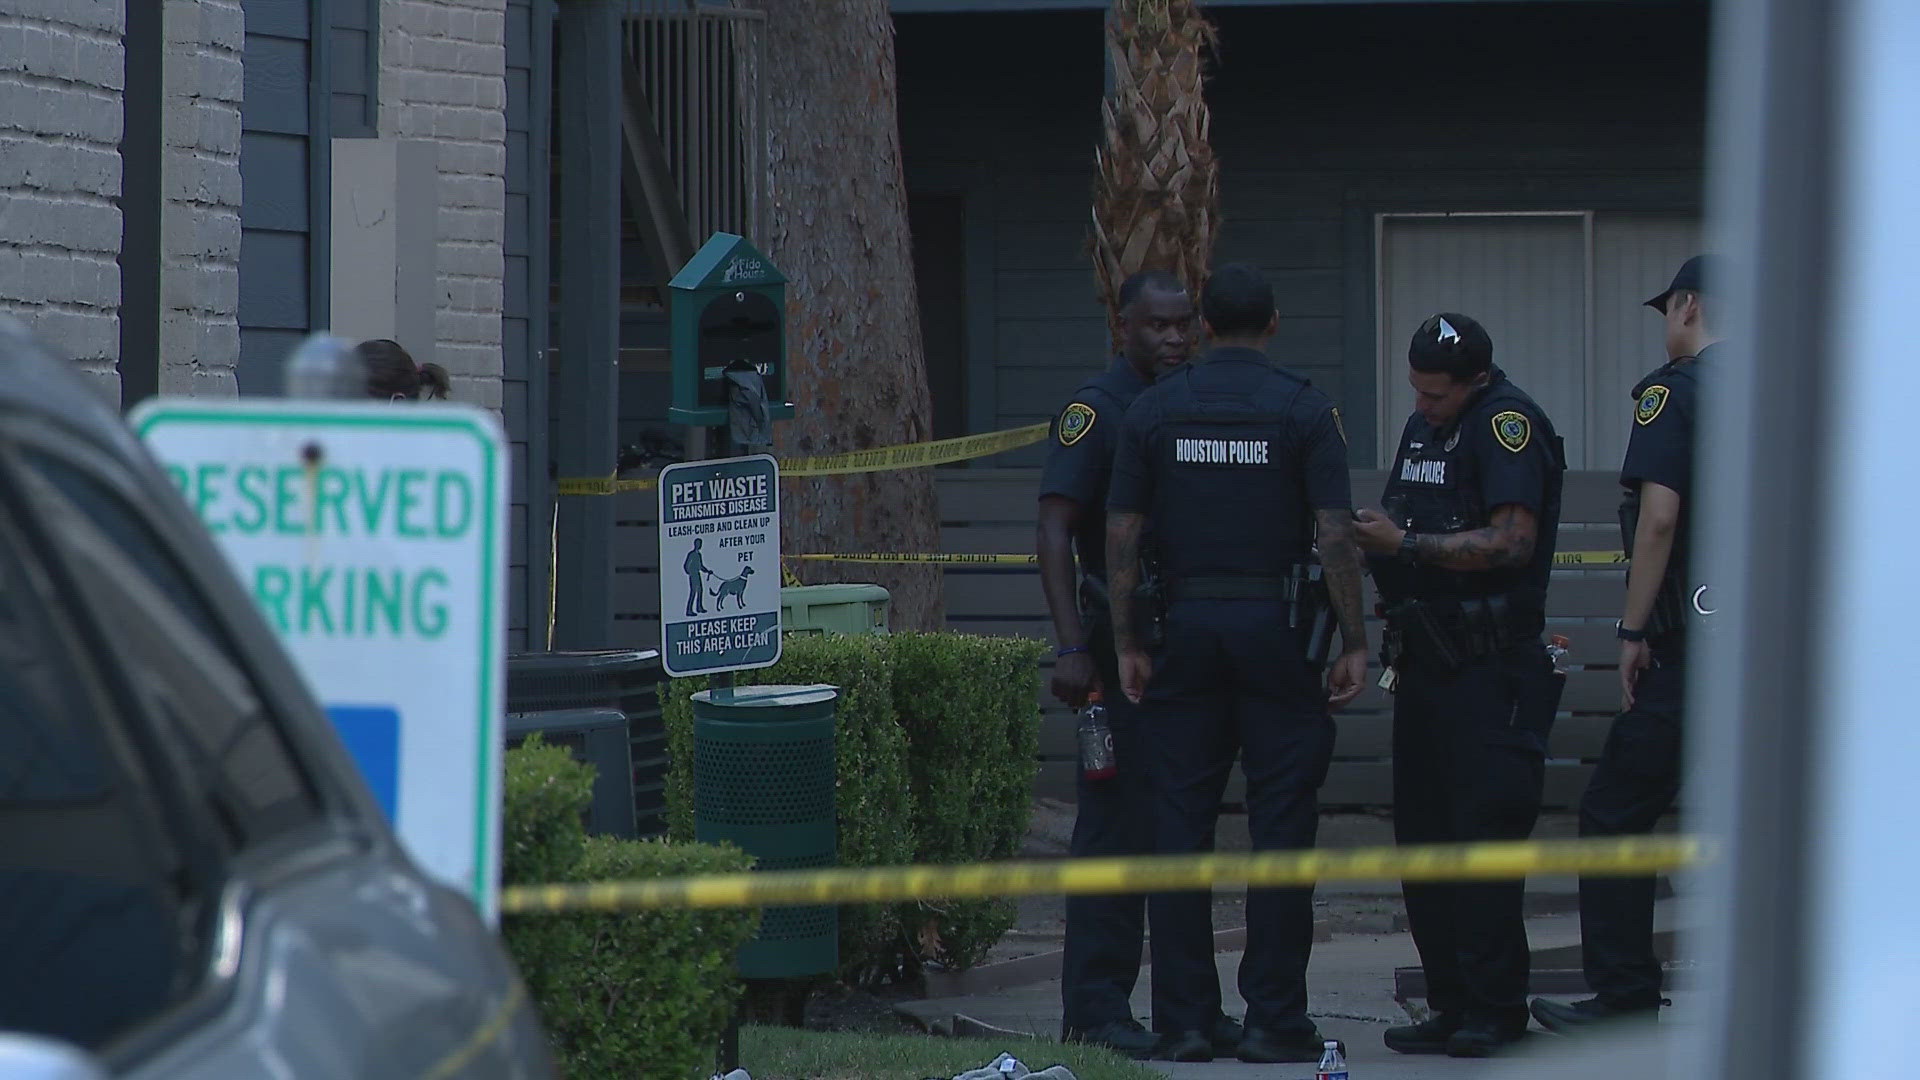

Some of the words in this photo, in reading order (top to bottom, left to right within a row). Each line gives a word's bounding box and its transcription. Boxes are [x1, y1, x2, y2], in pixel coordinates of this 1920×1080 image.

[739, 258, 761, 270] Fido
[1176, 438, 1227, 463] HOUSTON
[1229, 440, 1269, 464] POLICE
[1420, 460, 1446, 484] POLICE
[672, 482, 704, 504] PET
[709, 474, 767, 500] WASTE
[673, 501, 726, 520] TRANSMITS
[728, 498, 768, 514] DISEASE
[668, 523, 715, 537] LEASH-CURB
[717, 520, 732, 532] AND
[734, 518, 758, 531] CLEAN
[760, 516, 771, 528] UP
[719, 536, 743, 549] AFTER
[745, 533, 766, 546] YOUR
[737, 551, 754, 562] PET
[252, 564, 449, 638] RKING
[688, 620, 727, 638] PLEASE
[730, 616, 757, 632] KEEP
[677, 639, 701, 655] THIS
[704, 635, 732, 652] AREA
[735, 632, 769, 649] CLEAN
